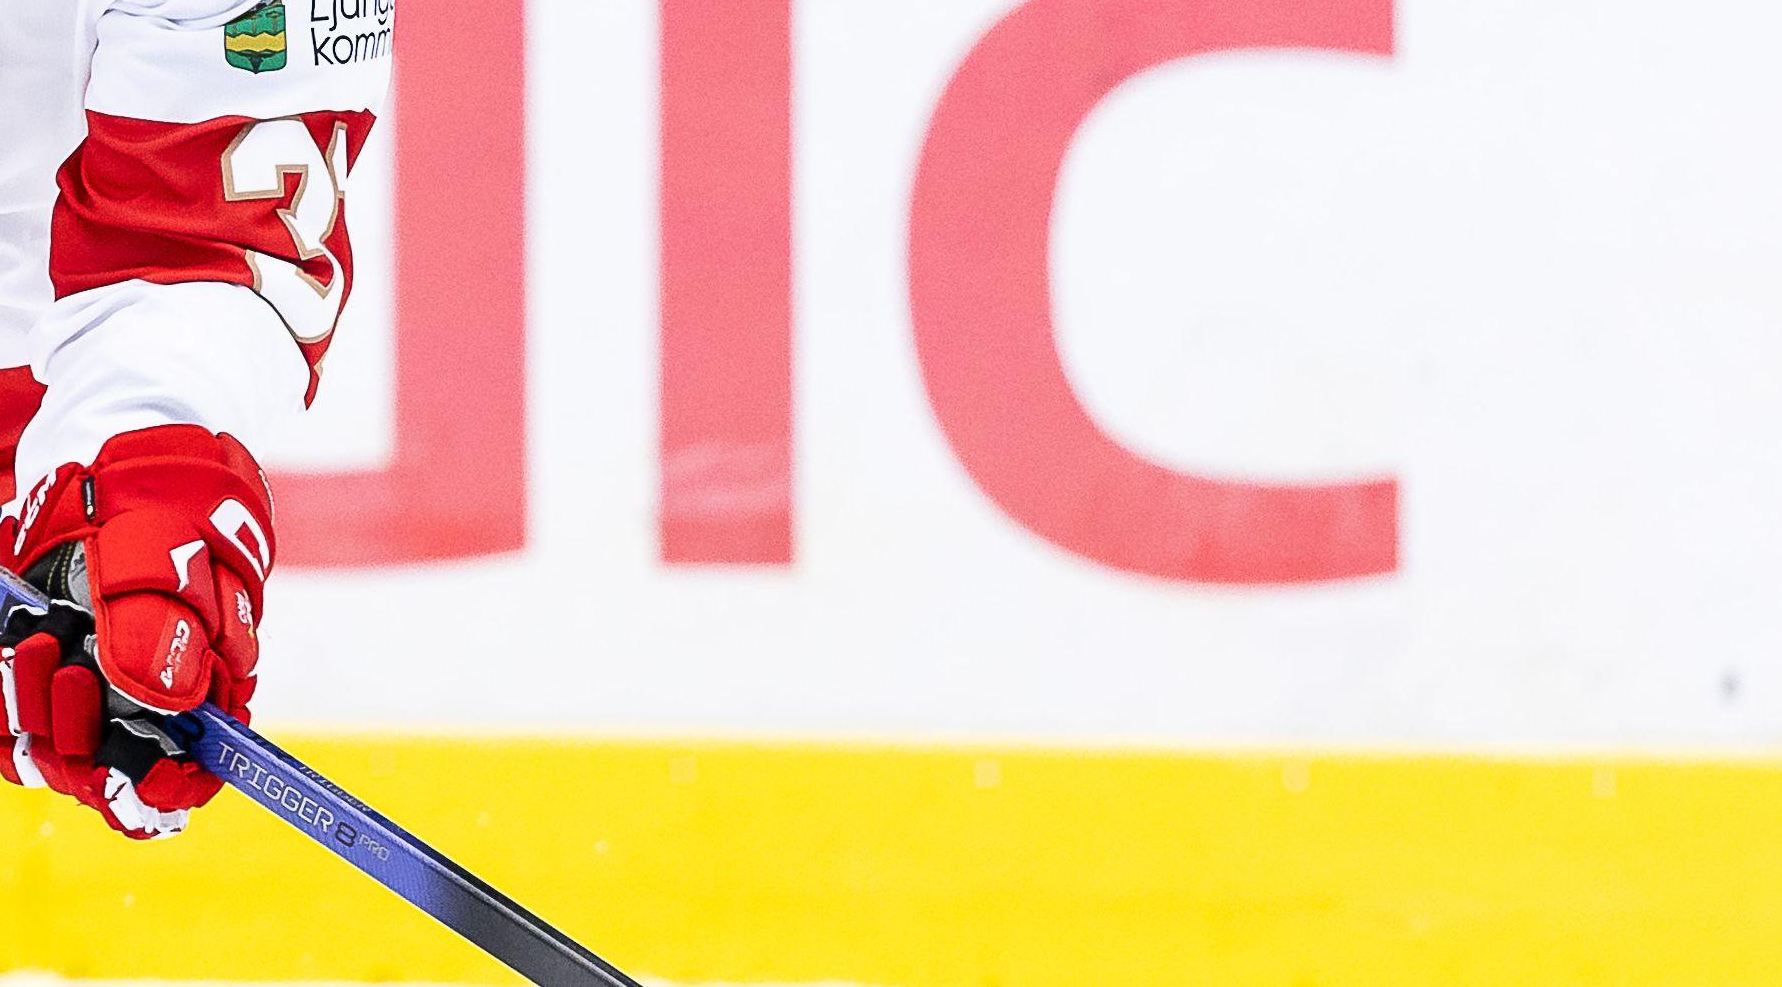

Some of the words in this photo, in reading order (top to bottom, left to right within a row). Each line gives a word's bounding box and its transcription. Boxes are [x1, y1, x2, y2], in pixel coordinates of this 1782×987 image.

[218, 742, 335, 833] TRIGGER
[335, 820, 357, 848] 8
[358, 834, 390, 861] PRO
